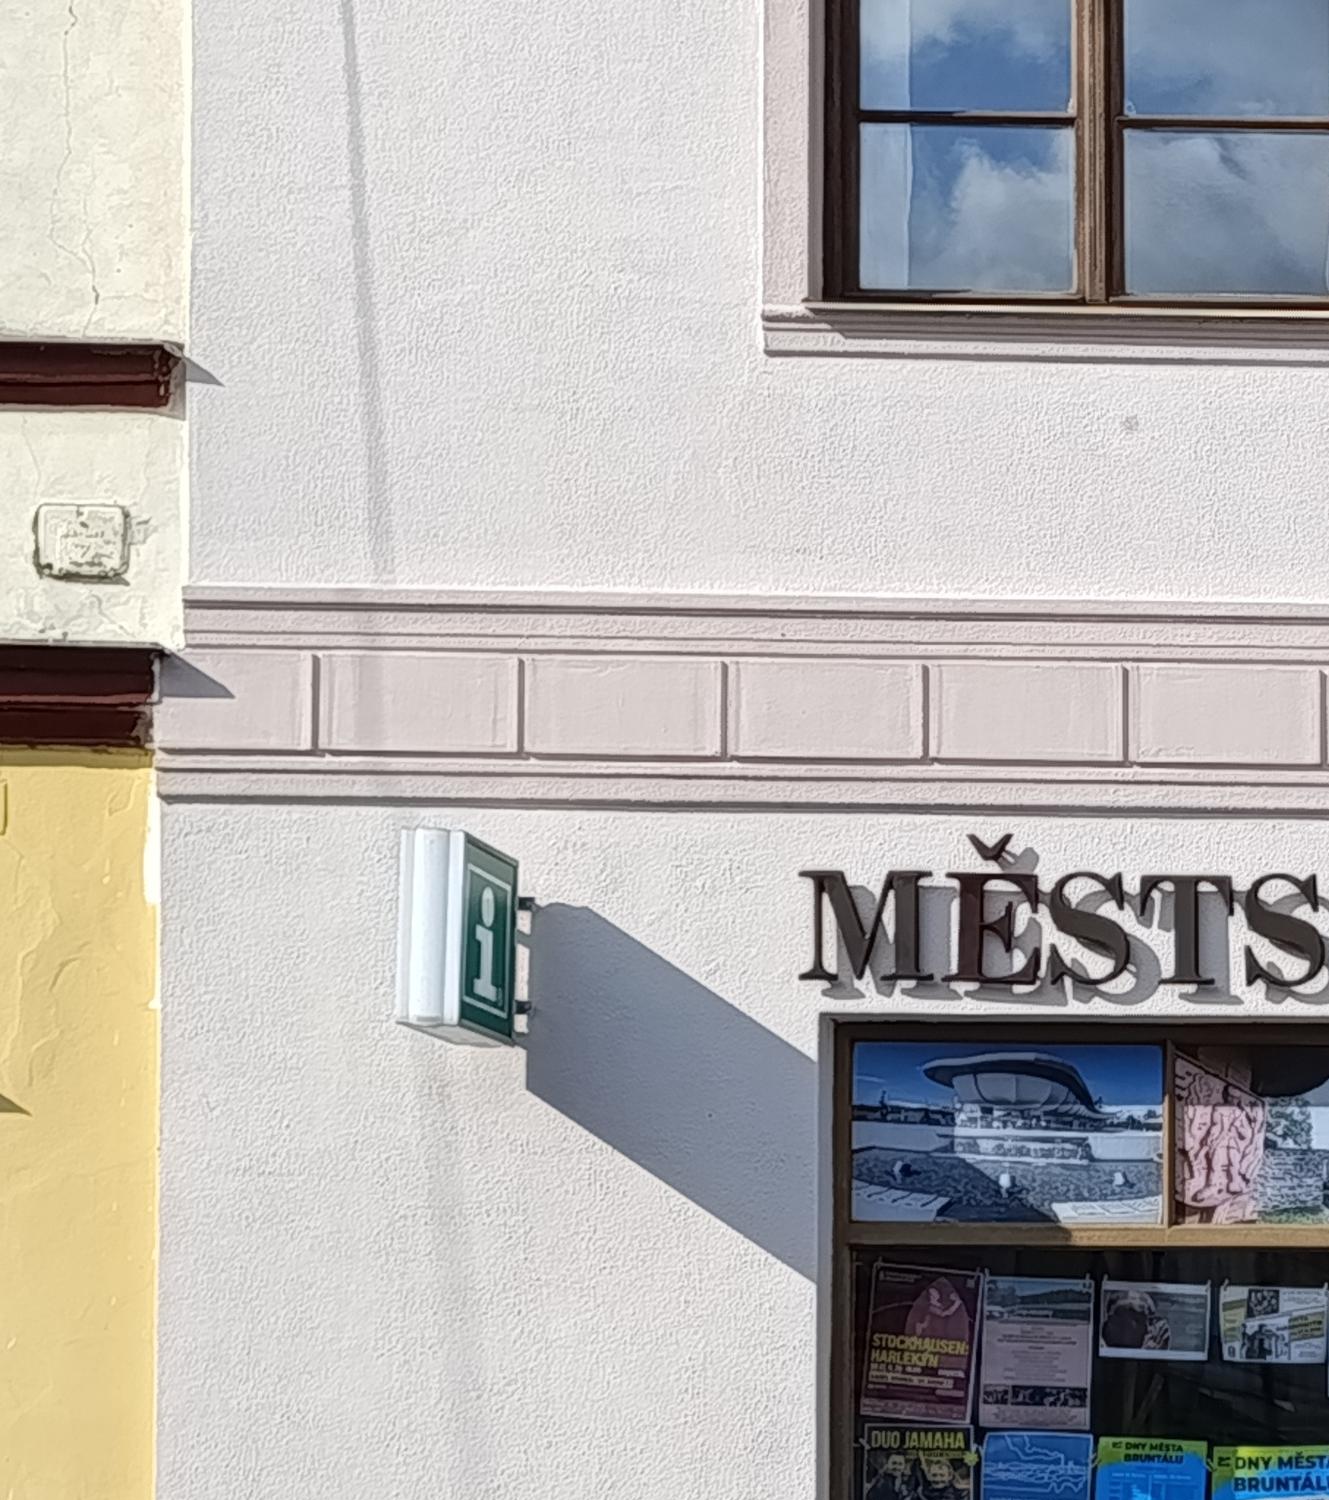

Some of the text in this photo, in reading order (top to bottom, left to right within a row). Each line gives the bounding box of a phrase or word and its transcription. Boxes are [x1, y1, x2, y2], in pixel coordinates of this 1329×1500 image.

[872, 1333, 969, 1356] STOCKHAUSEN:
[871, 1347, 939, 1369] HARLEKÝN
[871, 1430, 966, 1449] DUO JAMAHA
[1125, 1442, 1183, 1451] DNY MĚSTA
[1124, 1453, 1184, 1464] BRUNTÁLU
[1235, 1456, 1272, 1470] DNY
